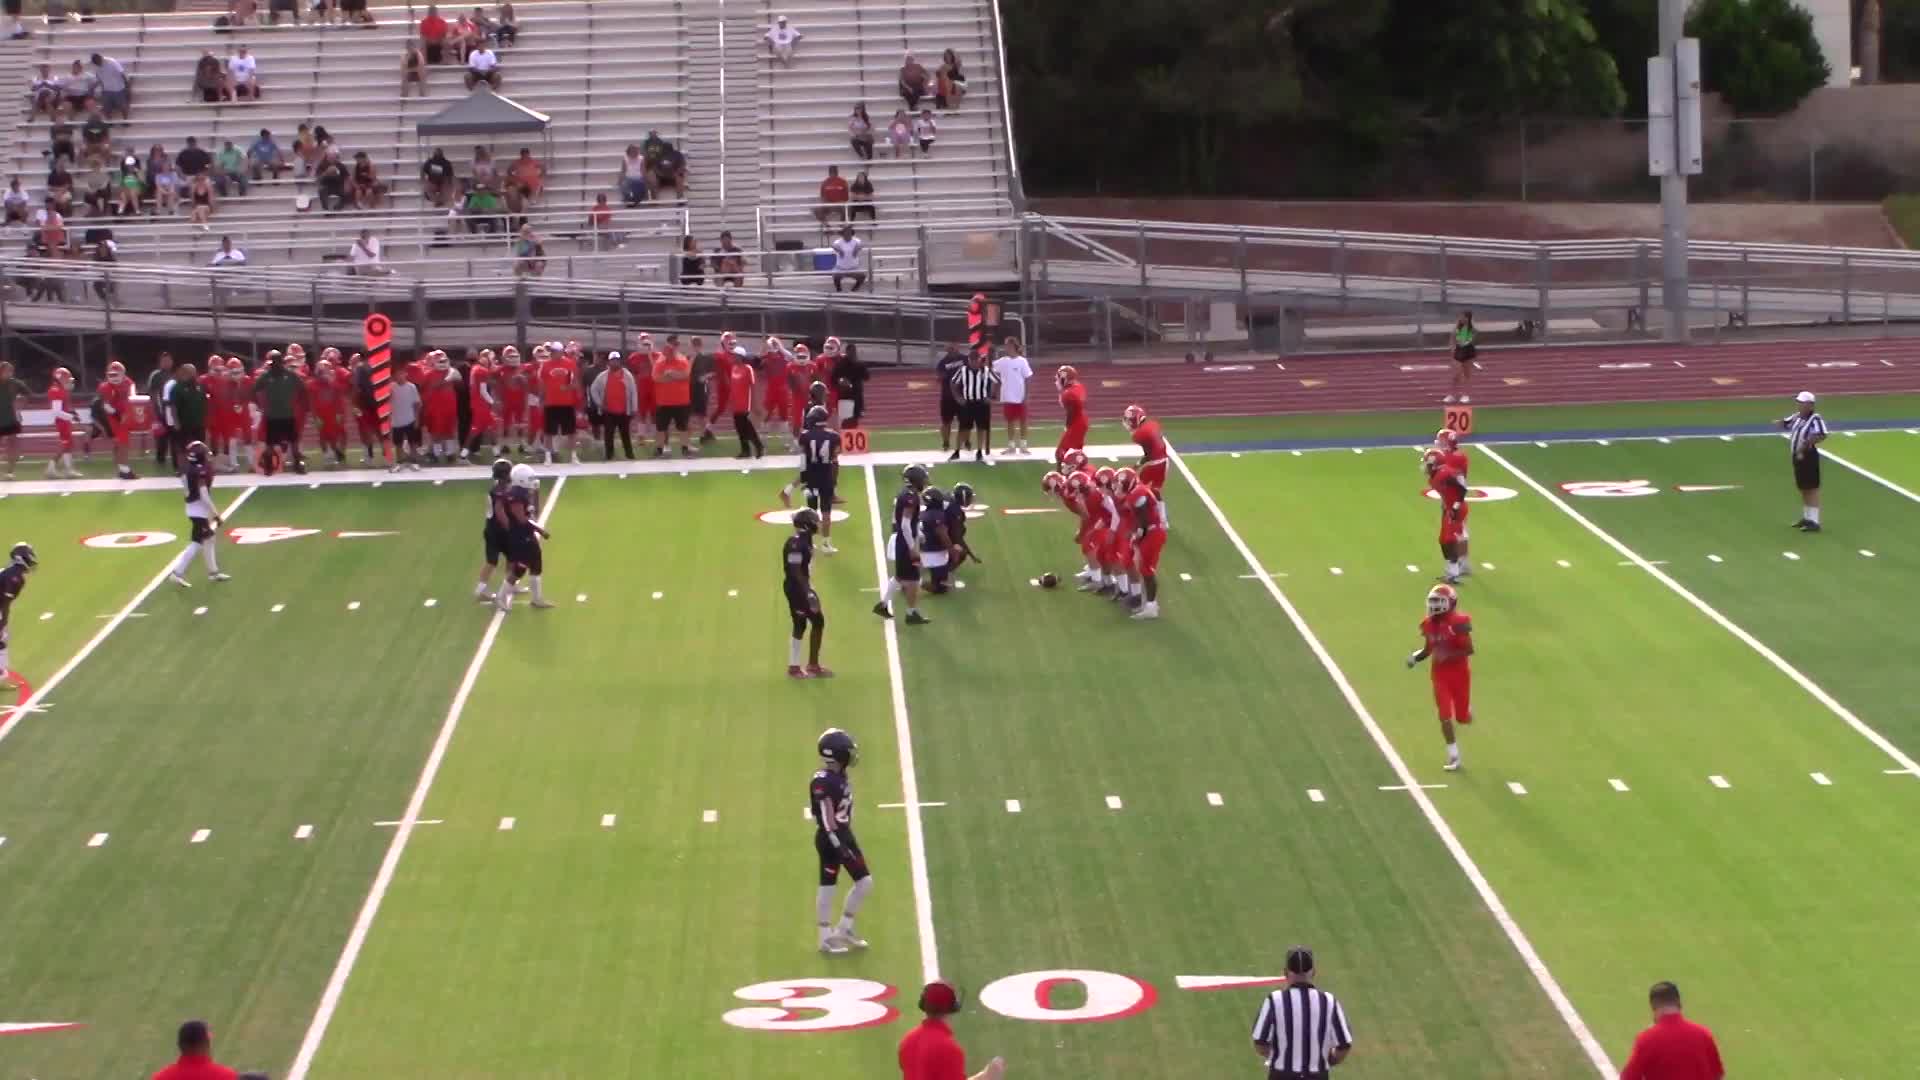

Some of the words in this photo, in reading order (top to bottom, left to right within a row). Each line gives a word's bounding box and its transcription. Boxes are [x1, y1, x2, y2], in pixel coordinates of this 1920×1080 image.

[1447, 411, 1470, 432] 20
[809, 439, 830, 463] 14
[844, 431, 866, 451] 30
